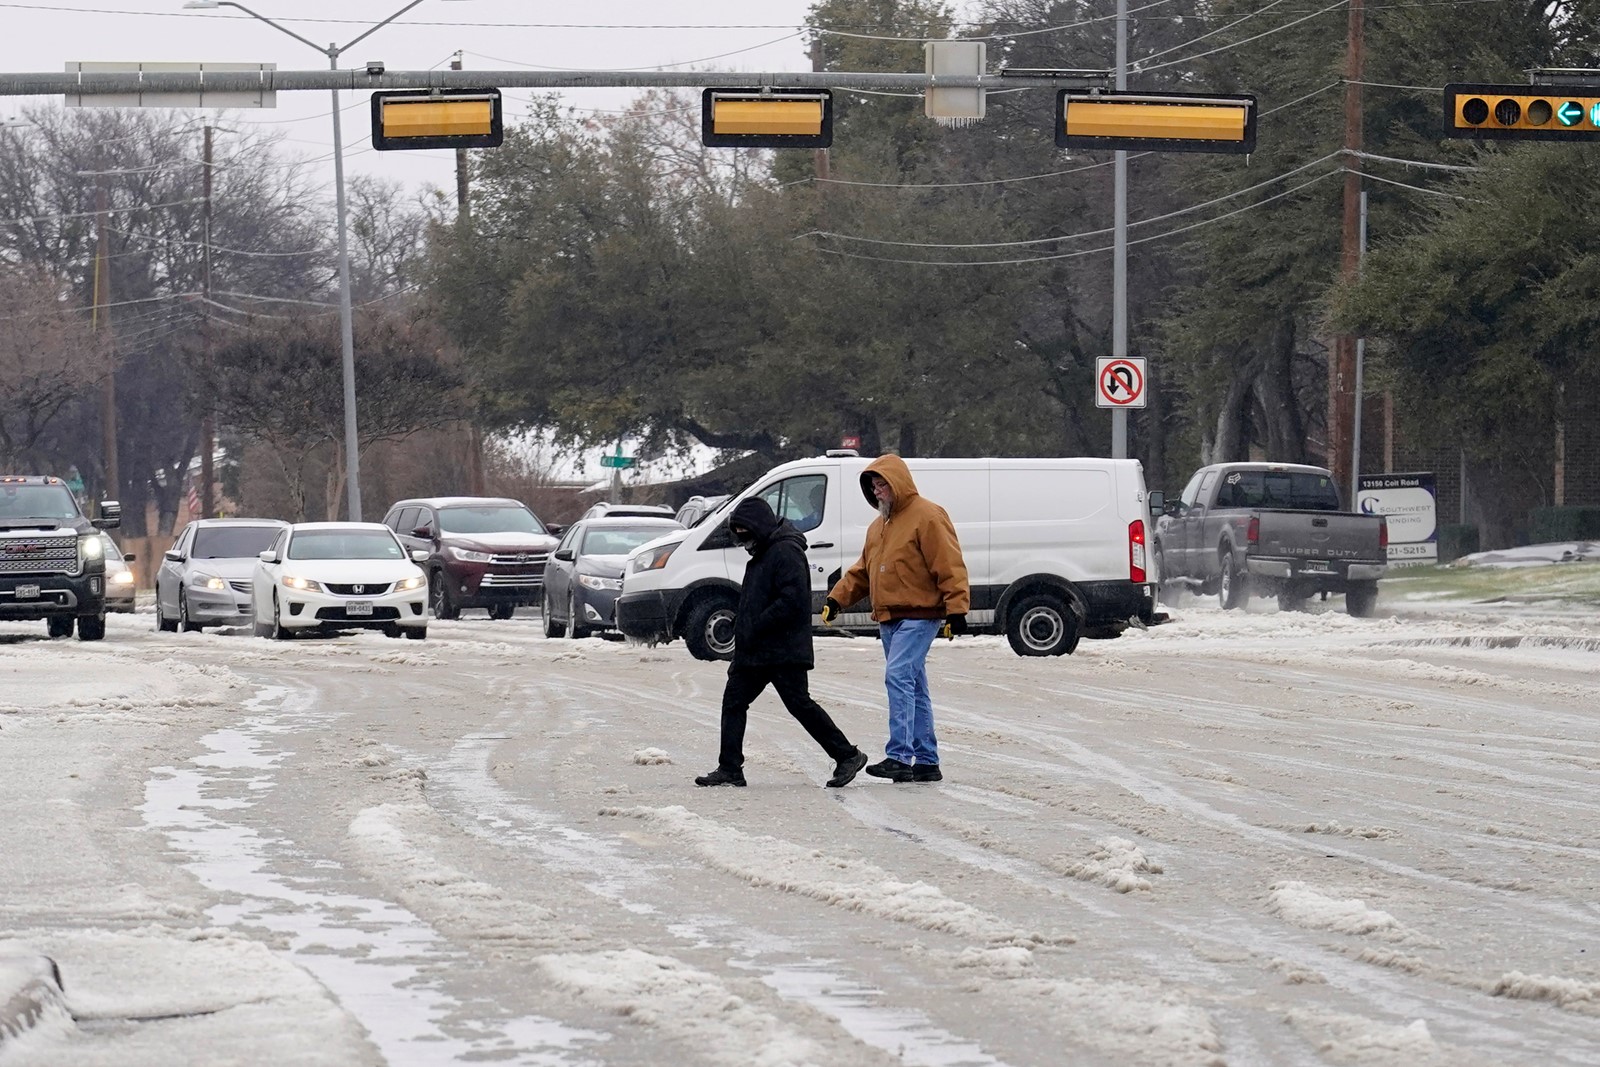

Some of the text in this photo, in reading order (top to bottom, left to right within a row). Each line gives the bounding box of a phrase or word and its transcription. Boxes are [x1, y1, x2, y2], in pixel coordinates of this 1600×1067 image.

[1379, 505, 1432, 513] SOUTHWEST
[5, 544, 45, 553] GMC
[1279, 547, 1358, 557] SUPER DUTY
[1388, 546, 1426, 555] 21-5215
